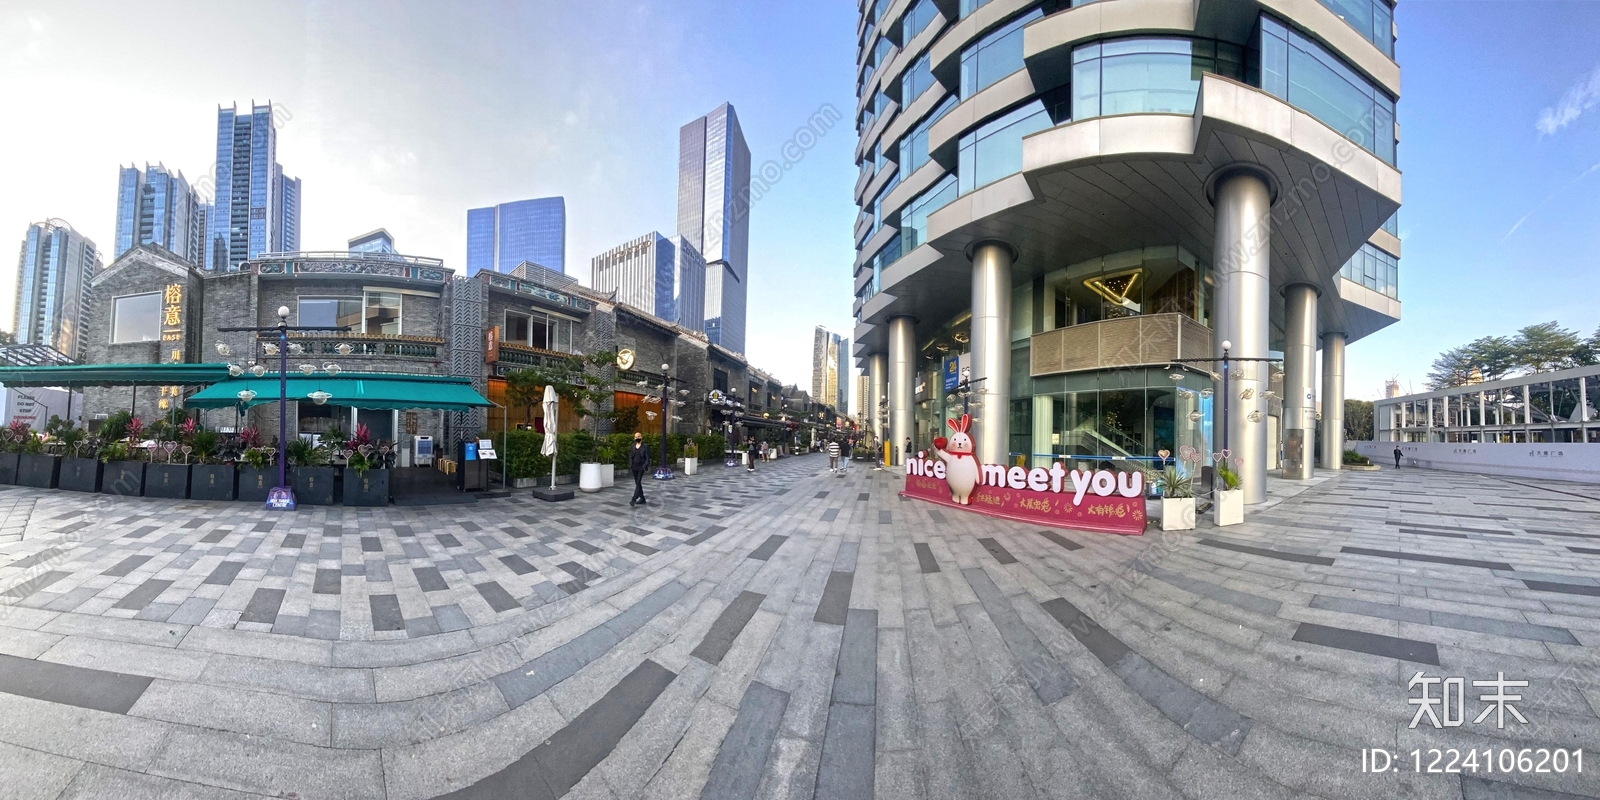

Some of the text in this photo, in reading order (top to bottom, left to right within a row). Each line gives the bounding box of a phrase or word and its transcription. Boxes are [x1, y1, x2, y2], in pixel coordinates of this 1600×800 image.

[163, 282, 182, 326] 榕意
[162, 334, 181, 342] EASE
[906, 450, 1143, 506] nice meet you
